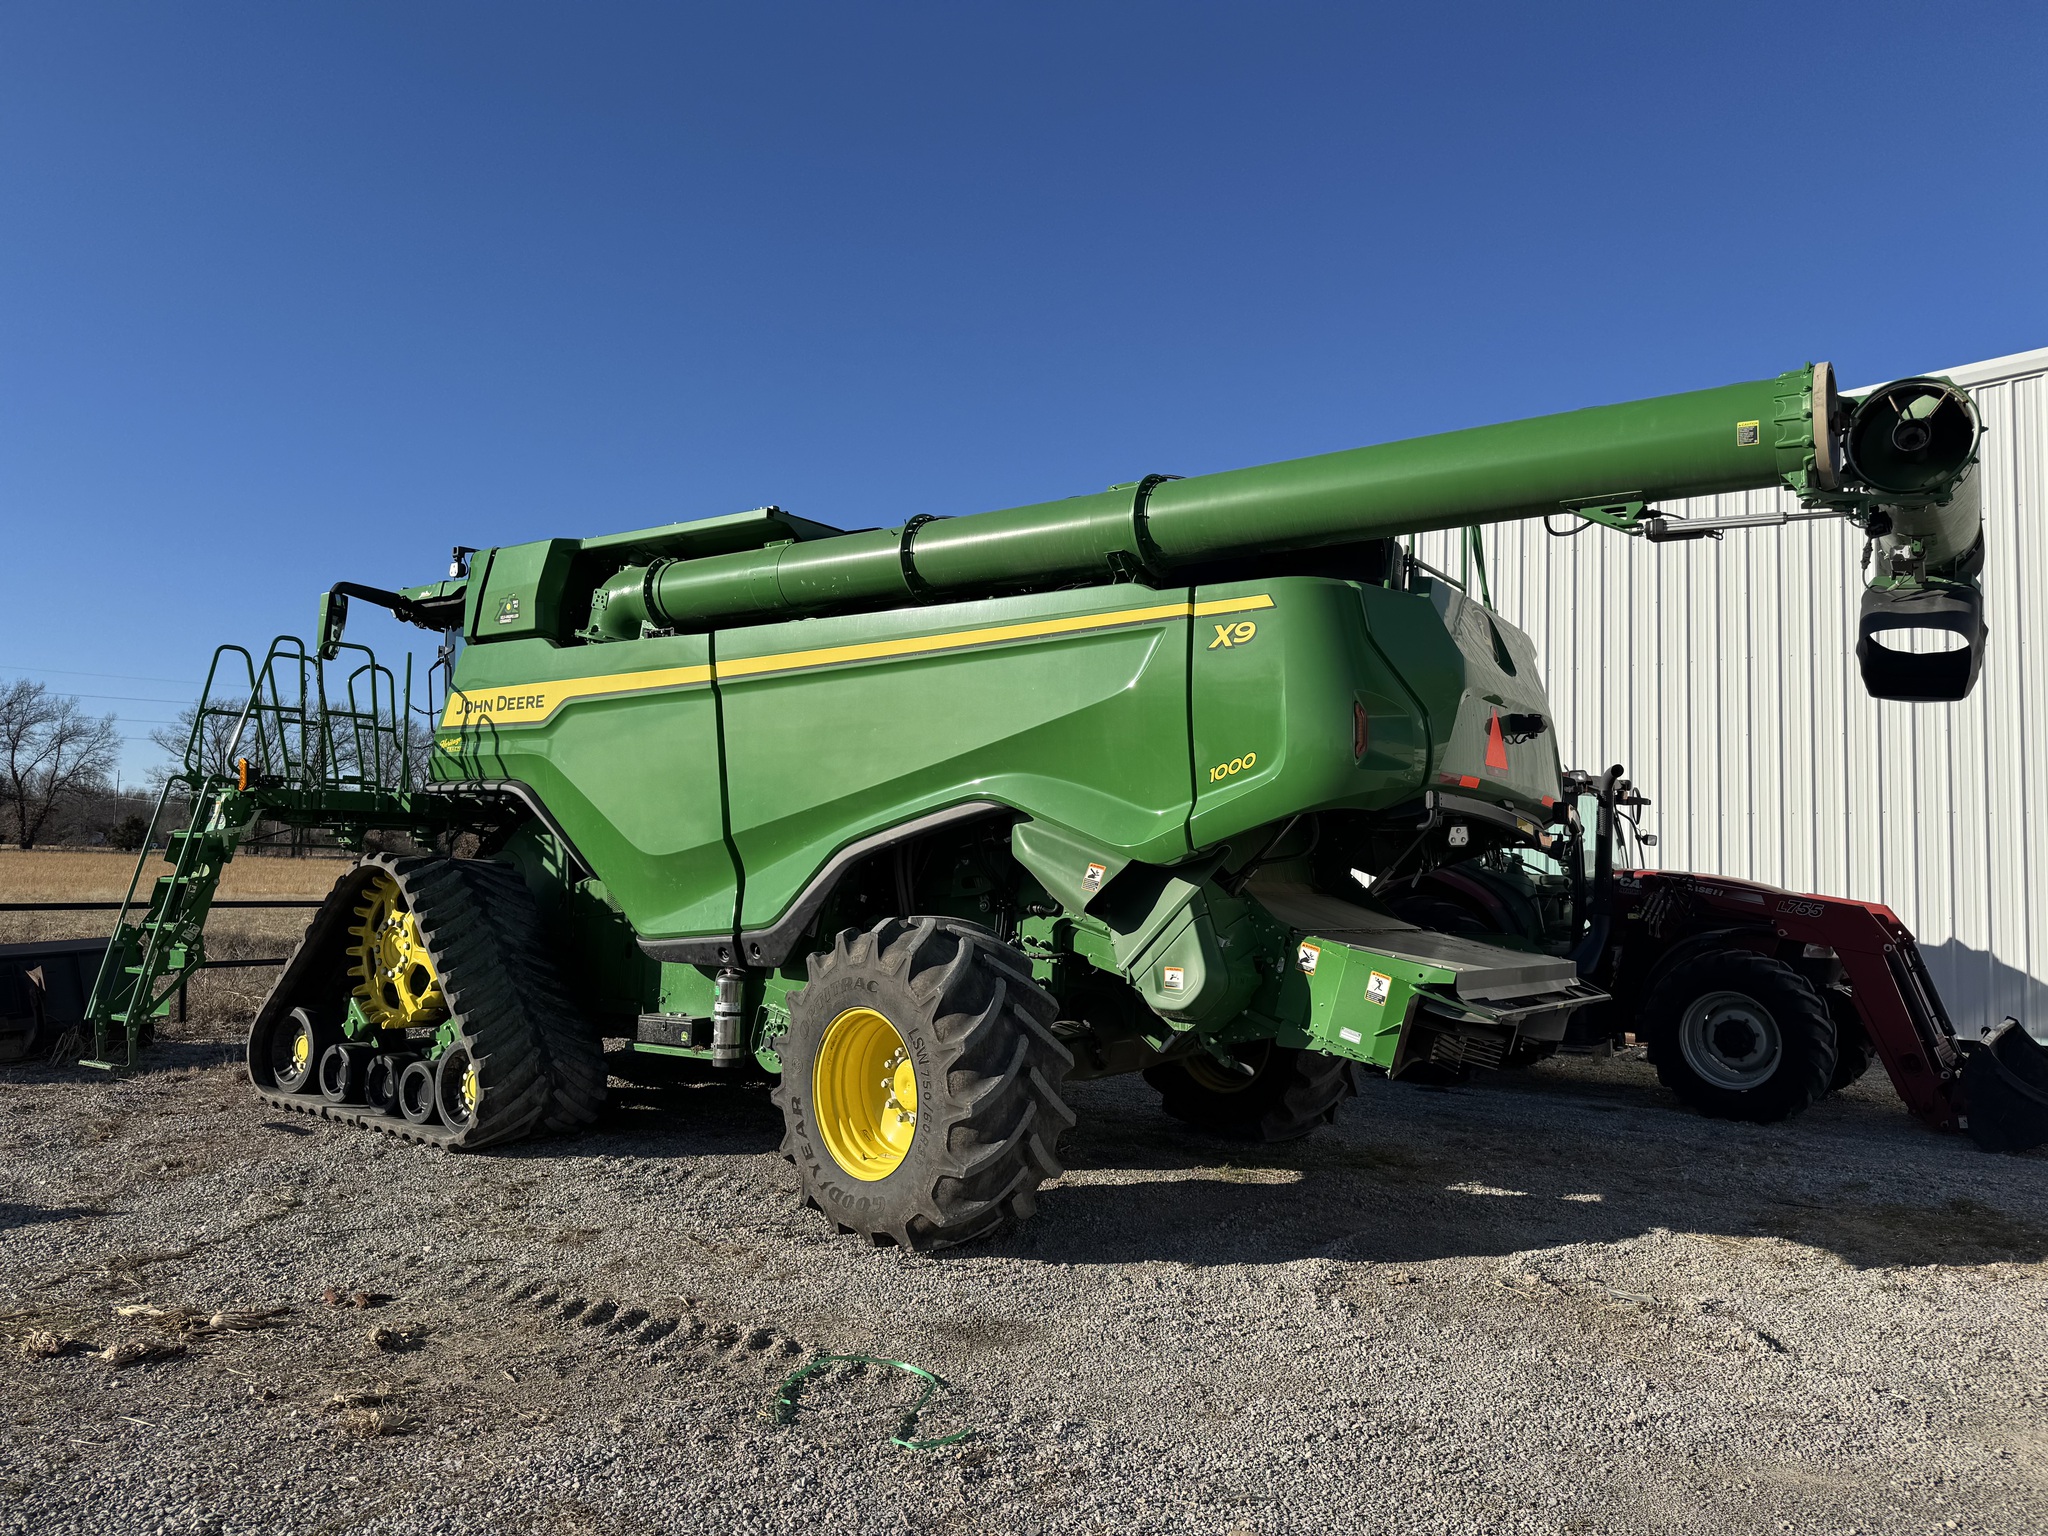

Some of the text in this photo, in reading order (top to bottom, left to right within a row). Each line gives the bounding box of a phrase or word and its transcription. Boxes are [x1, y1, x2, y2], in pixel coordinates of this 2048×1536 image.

[1207, 621, 1257, 650] X9
[456, 695, 545, 715] JOHN DEERE
[1210, 752, 1257, 783] 1000
[1776, 901, 1824, 918] L755
[907, 1027, 931, 1066] LSW
[790, 1096, 887, 1214] GOODYEAR
